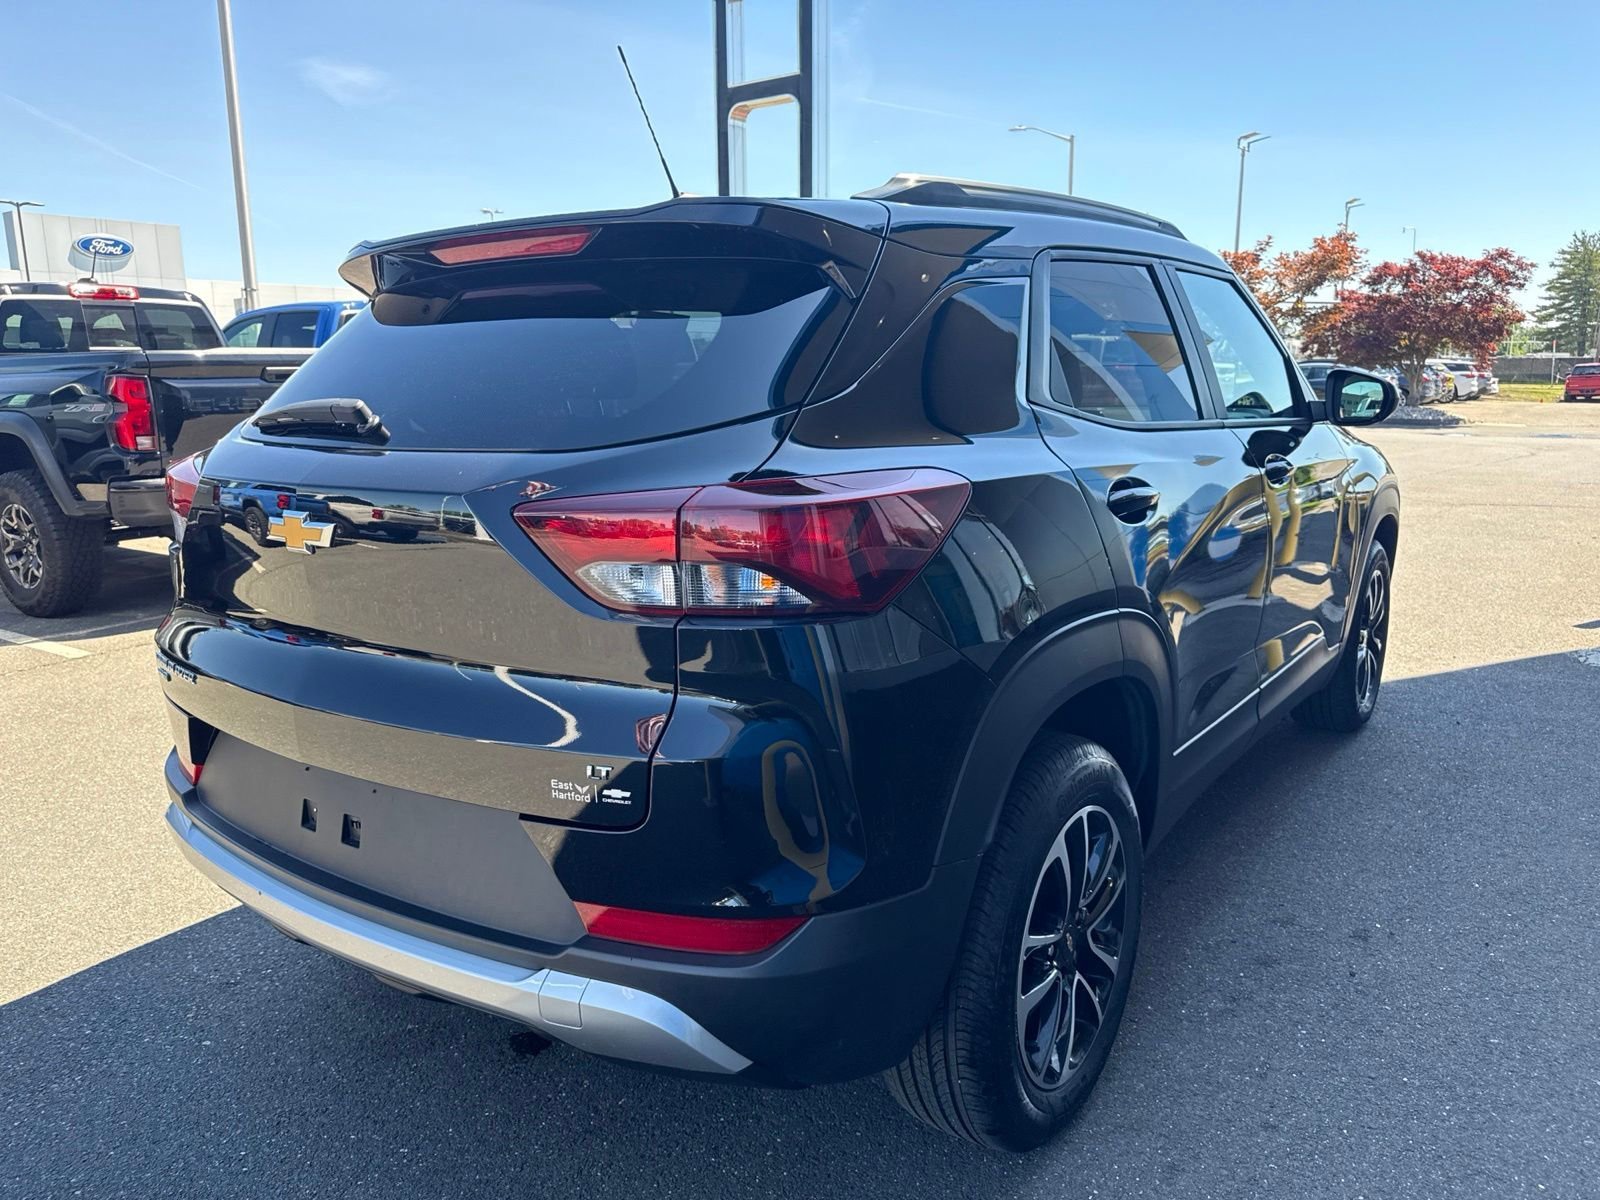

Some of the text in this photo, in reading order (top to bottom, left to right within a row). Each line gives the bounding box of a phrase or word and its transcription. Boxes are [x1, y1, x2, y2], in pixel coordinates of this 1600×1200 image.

[89, 238, 124, 254] Ford
[586, 764, 614, 780] LT
[551, 779, 574, 791] East
[551, 789, 591, 803] Hartford
